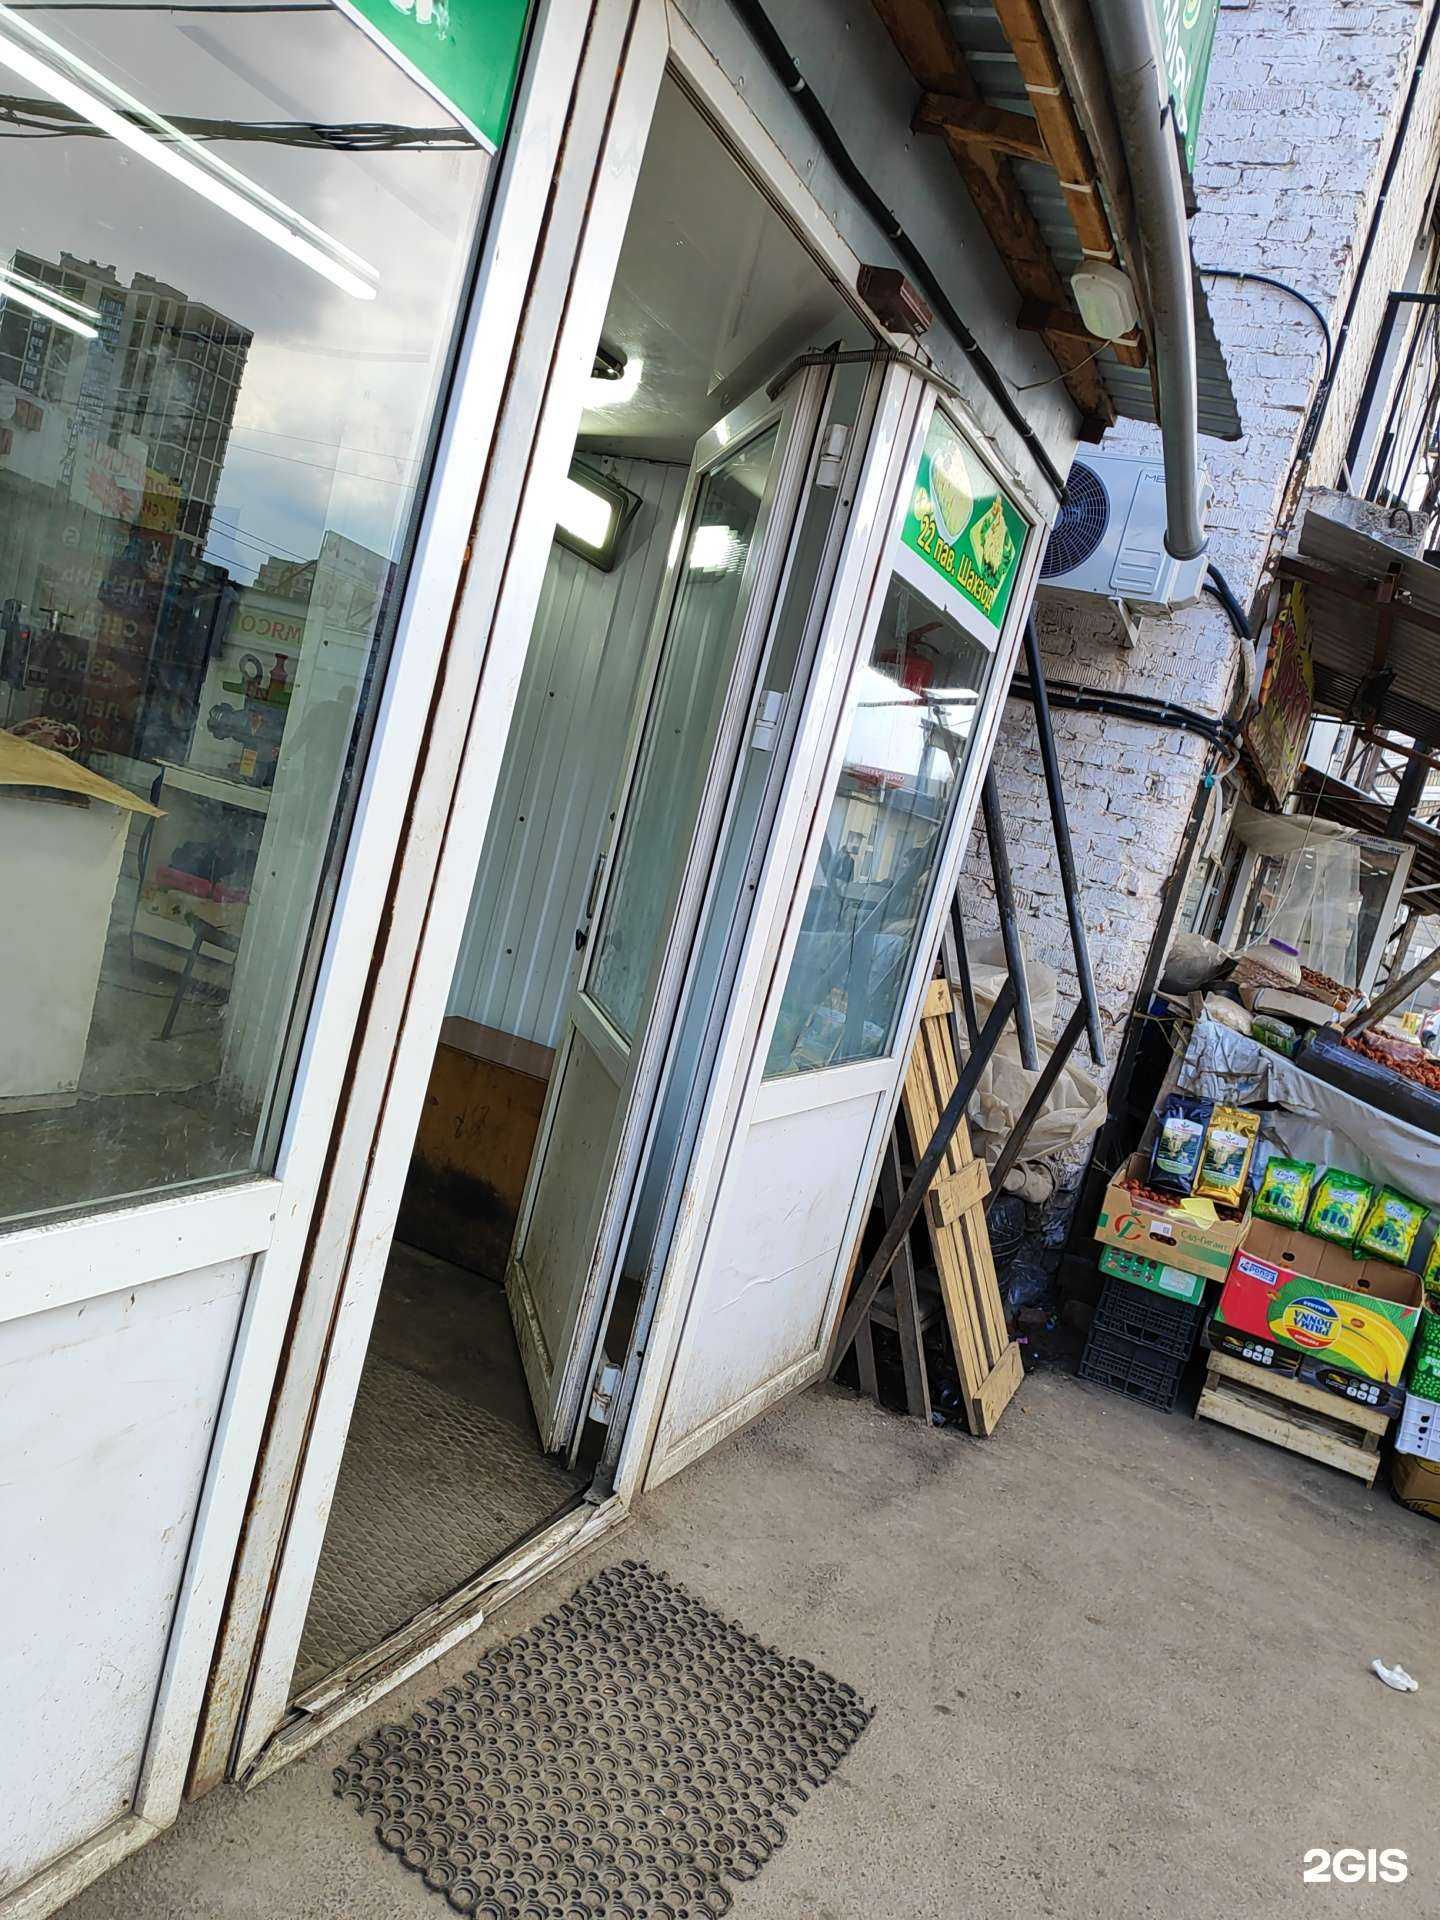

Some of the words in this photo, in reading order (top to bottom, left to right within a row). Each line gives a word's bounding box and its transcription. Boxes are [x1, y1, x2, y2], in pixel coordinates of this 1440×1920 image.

[917, 514, 936, 554] 22
[933, 536, 956, 576] пав.
[956, 552, 995, 617] Шахзод
[1294, 1309, 1333, 1329] DONNA
[1294, 1317, 1330, 1336] PRIMA
